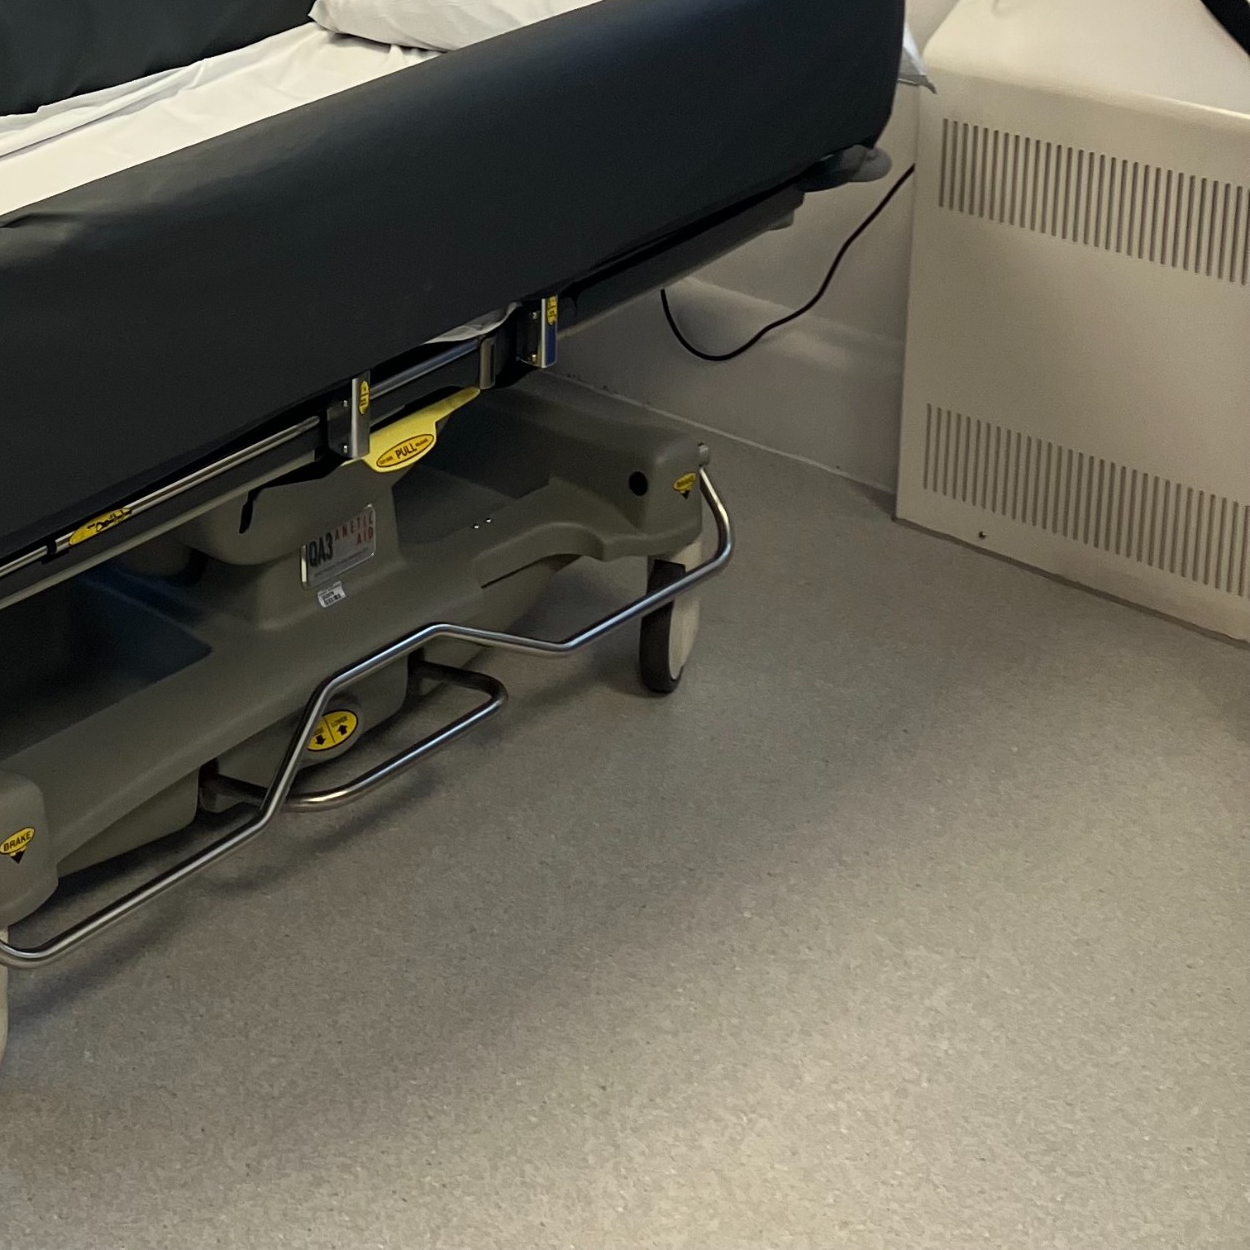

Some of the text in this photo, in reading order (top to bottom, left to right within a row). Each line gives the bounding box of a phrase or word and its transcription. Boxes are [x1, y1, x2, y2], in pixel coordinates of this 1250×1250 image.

[395, 442, 418, 459] PULL
[356, 526, 374, 545] AID
[309, 532, 334, 568] QA3
[3, 830, 31, 852] BRAKE
